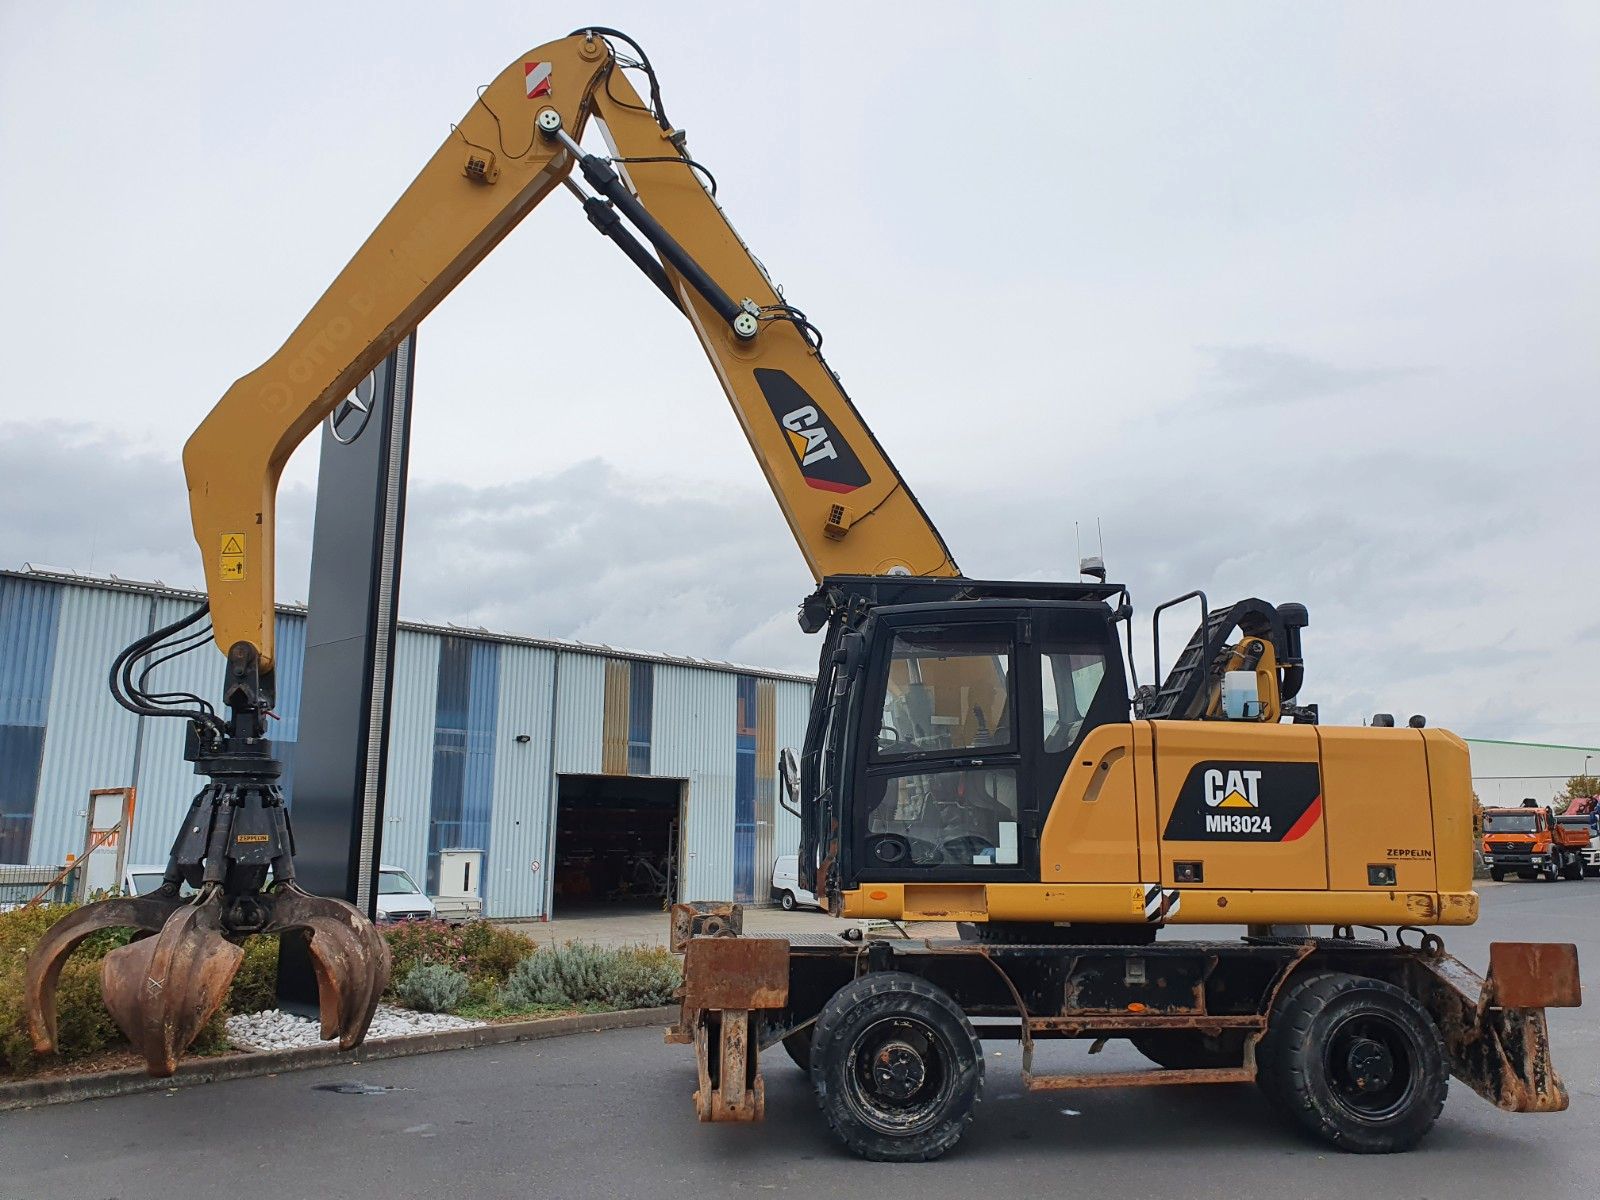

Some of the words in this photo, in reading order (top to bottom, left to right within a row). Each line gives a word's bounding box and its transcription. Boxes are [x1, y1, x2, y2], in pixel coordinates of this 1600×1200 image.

[782, 405, 838, 467] CAT
[1204, 769, 1262, 808] CAT
[1205, 815, 1272, 833] MH3024
[1386, 848, 1432, 857] ZEPPELIN
